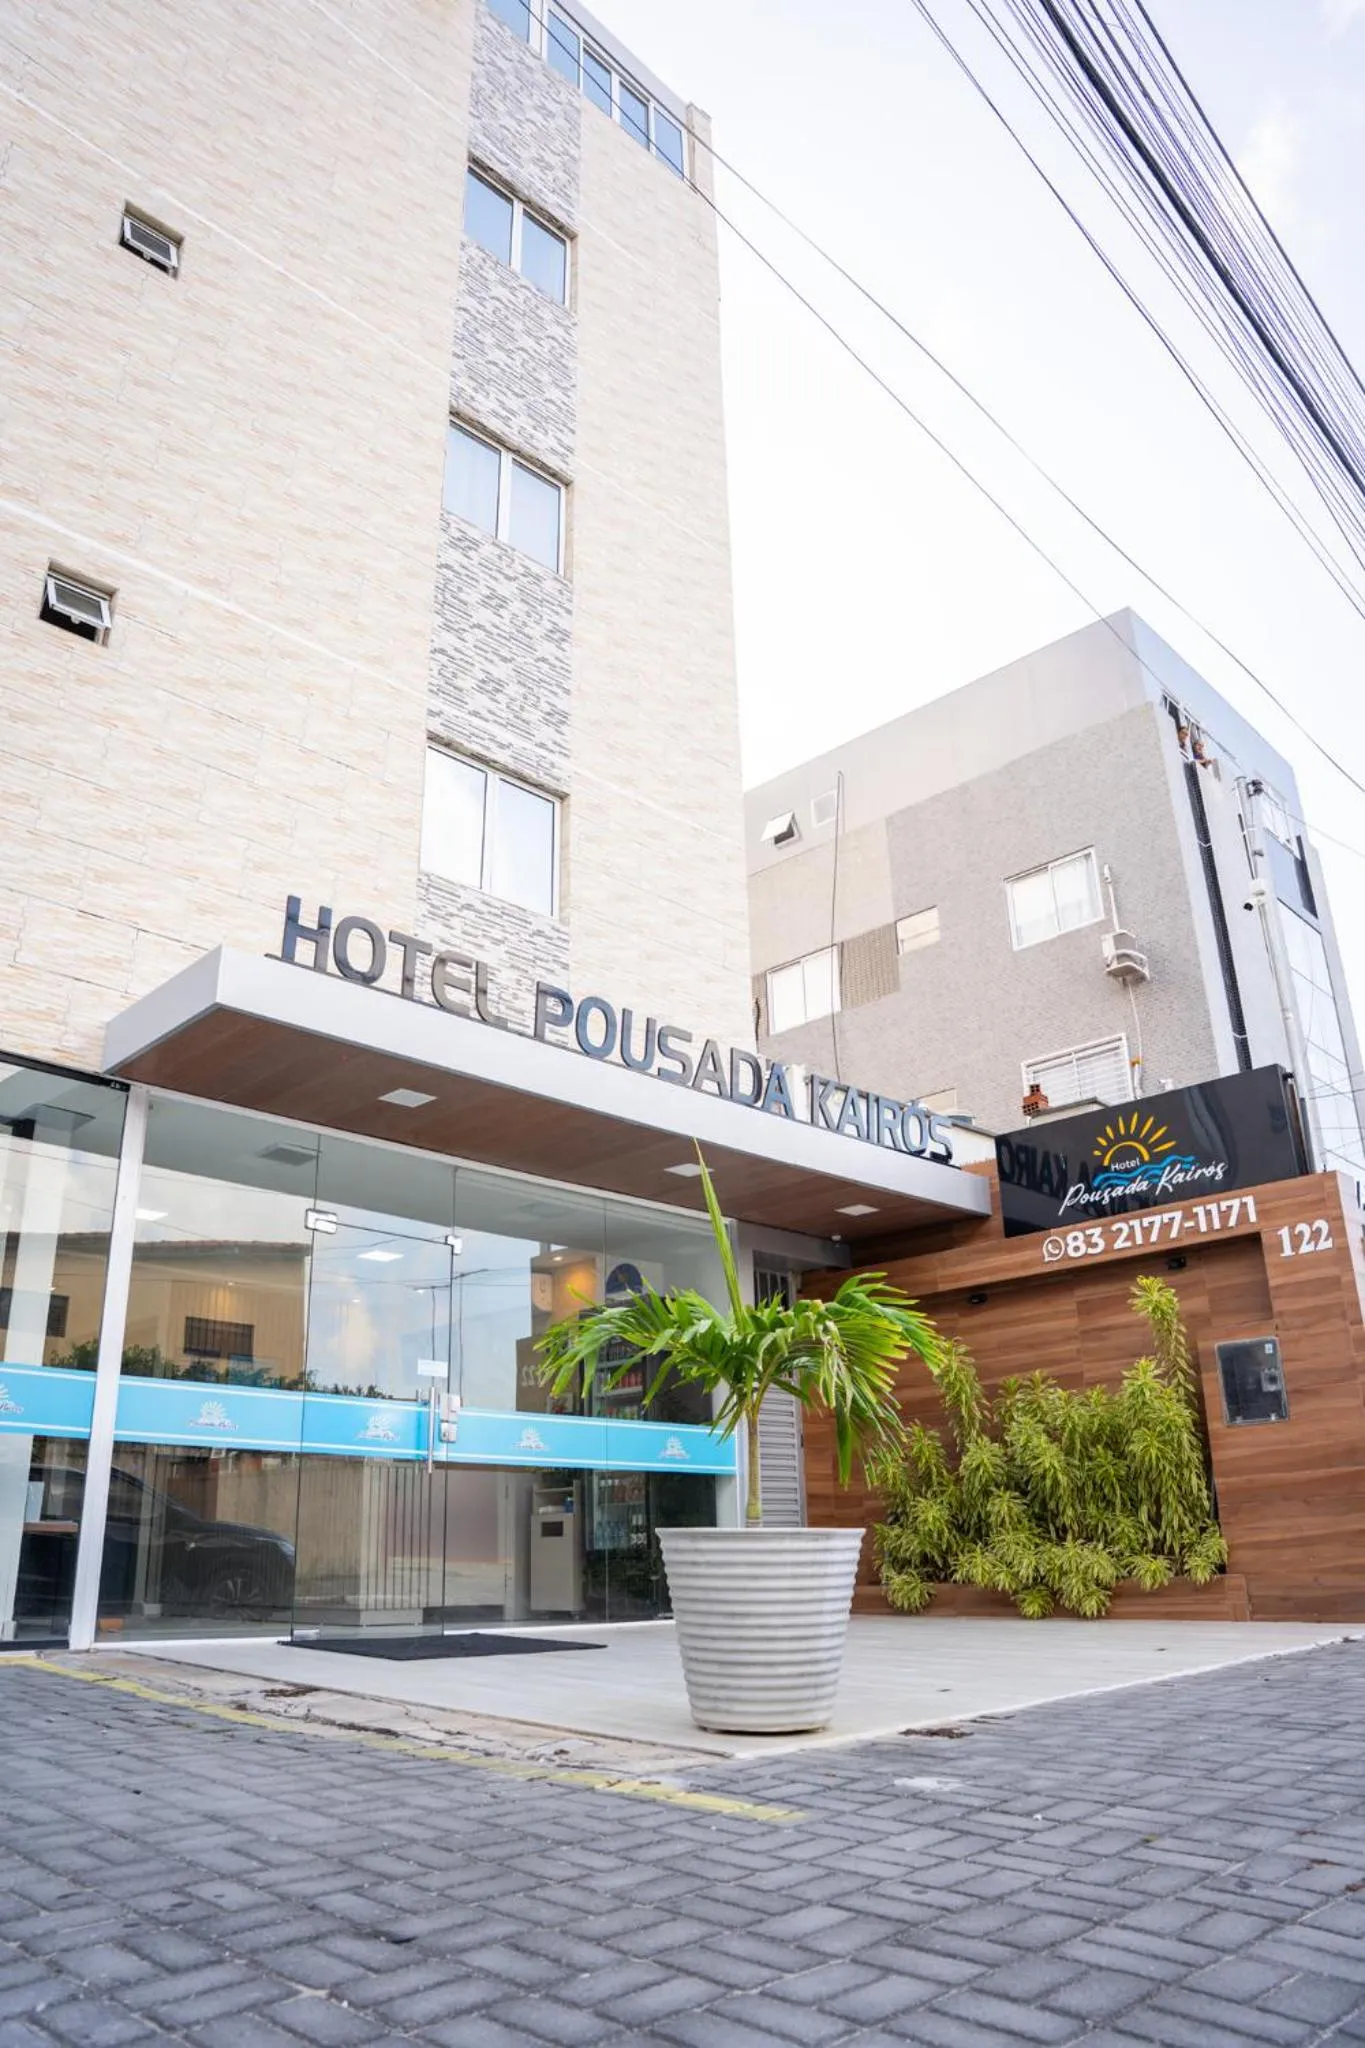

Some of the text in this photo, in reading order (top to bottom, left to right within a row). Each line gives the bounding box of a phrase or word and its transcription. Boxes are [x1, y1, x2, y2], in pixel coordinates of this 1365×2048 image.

[281, 895, 509, 1029] HOTEL
[534, 981, 795, 1120] POUSADA
[1058, 1159, 1229, 1216] Pousada Kairós
[1111, 1157, 1141, 1172] Hotel
[1065, 1195, 1257, 1258] 83 2177-1171
[1277, 1219, 1333, 1257] 122
